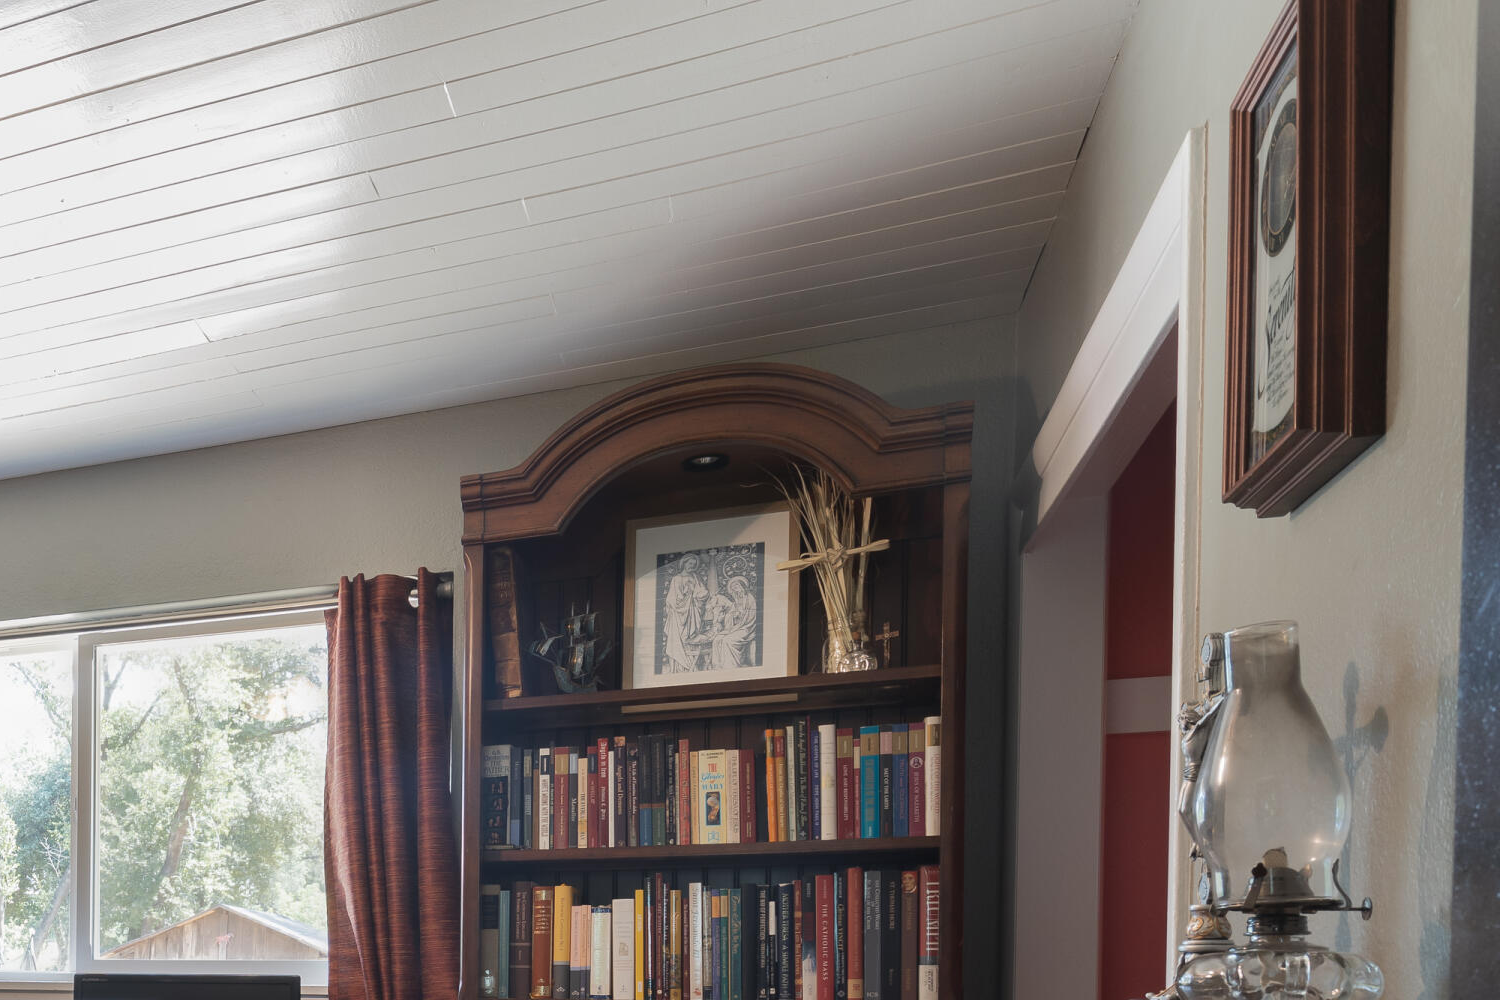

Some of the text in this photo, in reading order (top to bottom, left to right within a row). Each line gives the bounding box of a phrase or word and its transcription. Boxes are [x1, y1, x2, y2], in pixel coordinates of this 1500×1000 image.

[708, 763, 717, 773] THE
[616, 766, 624, 782] Angels
[616, 782, 624, 793] and
